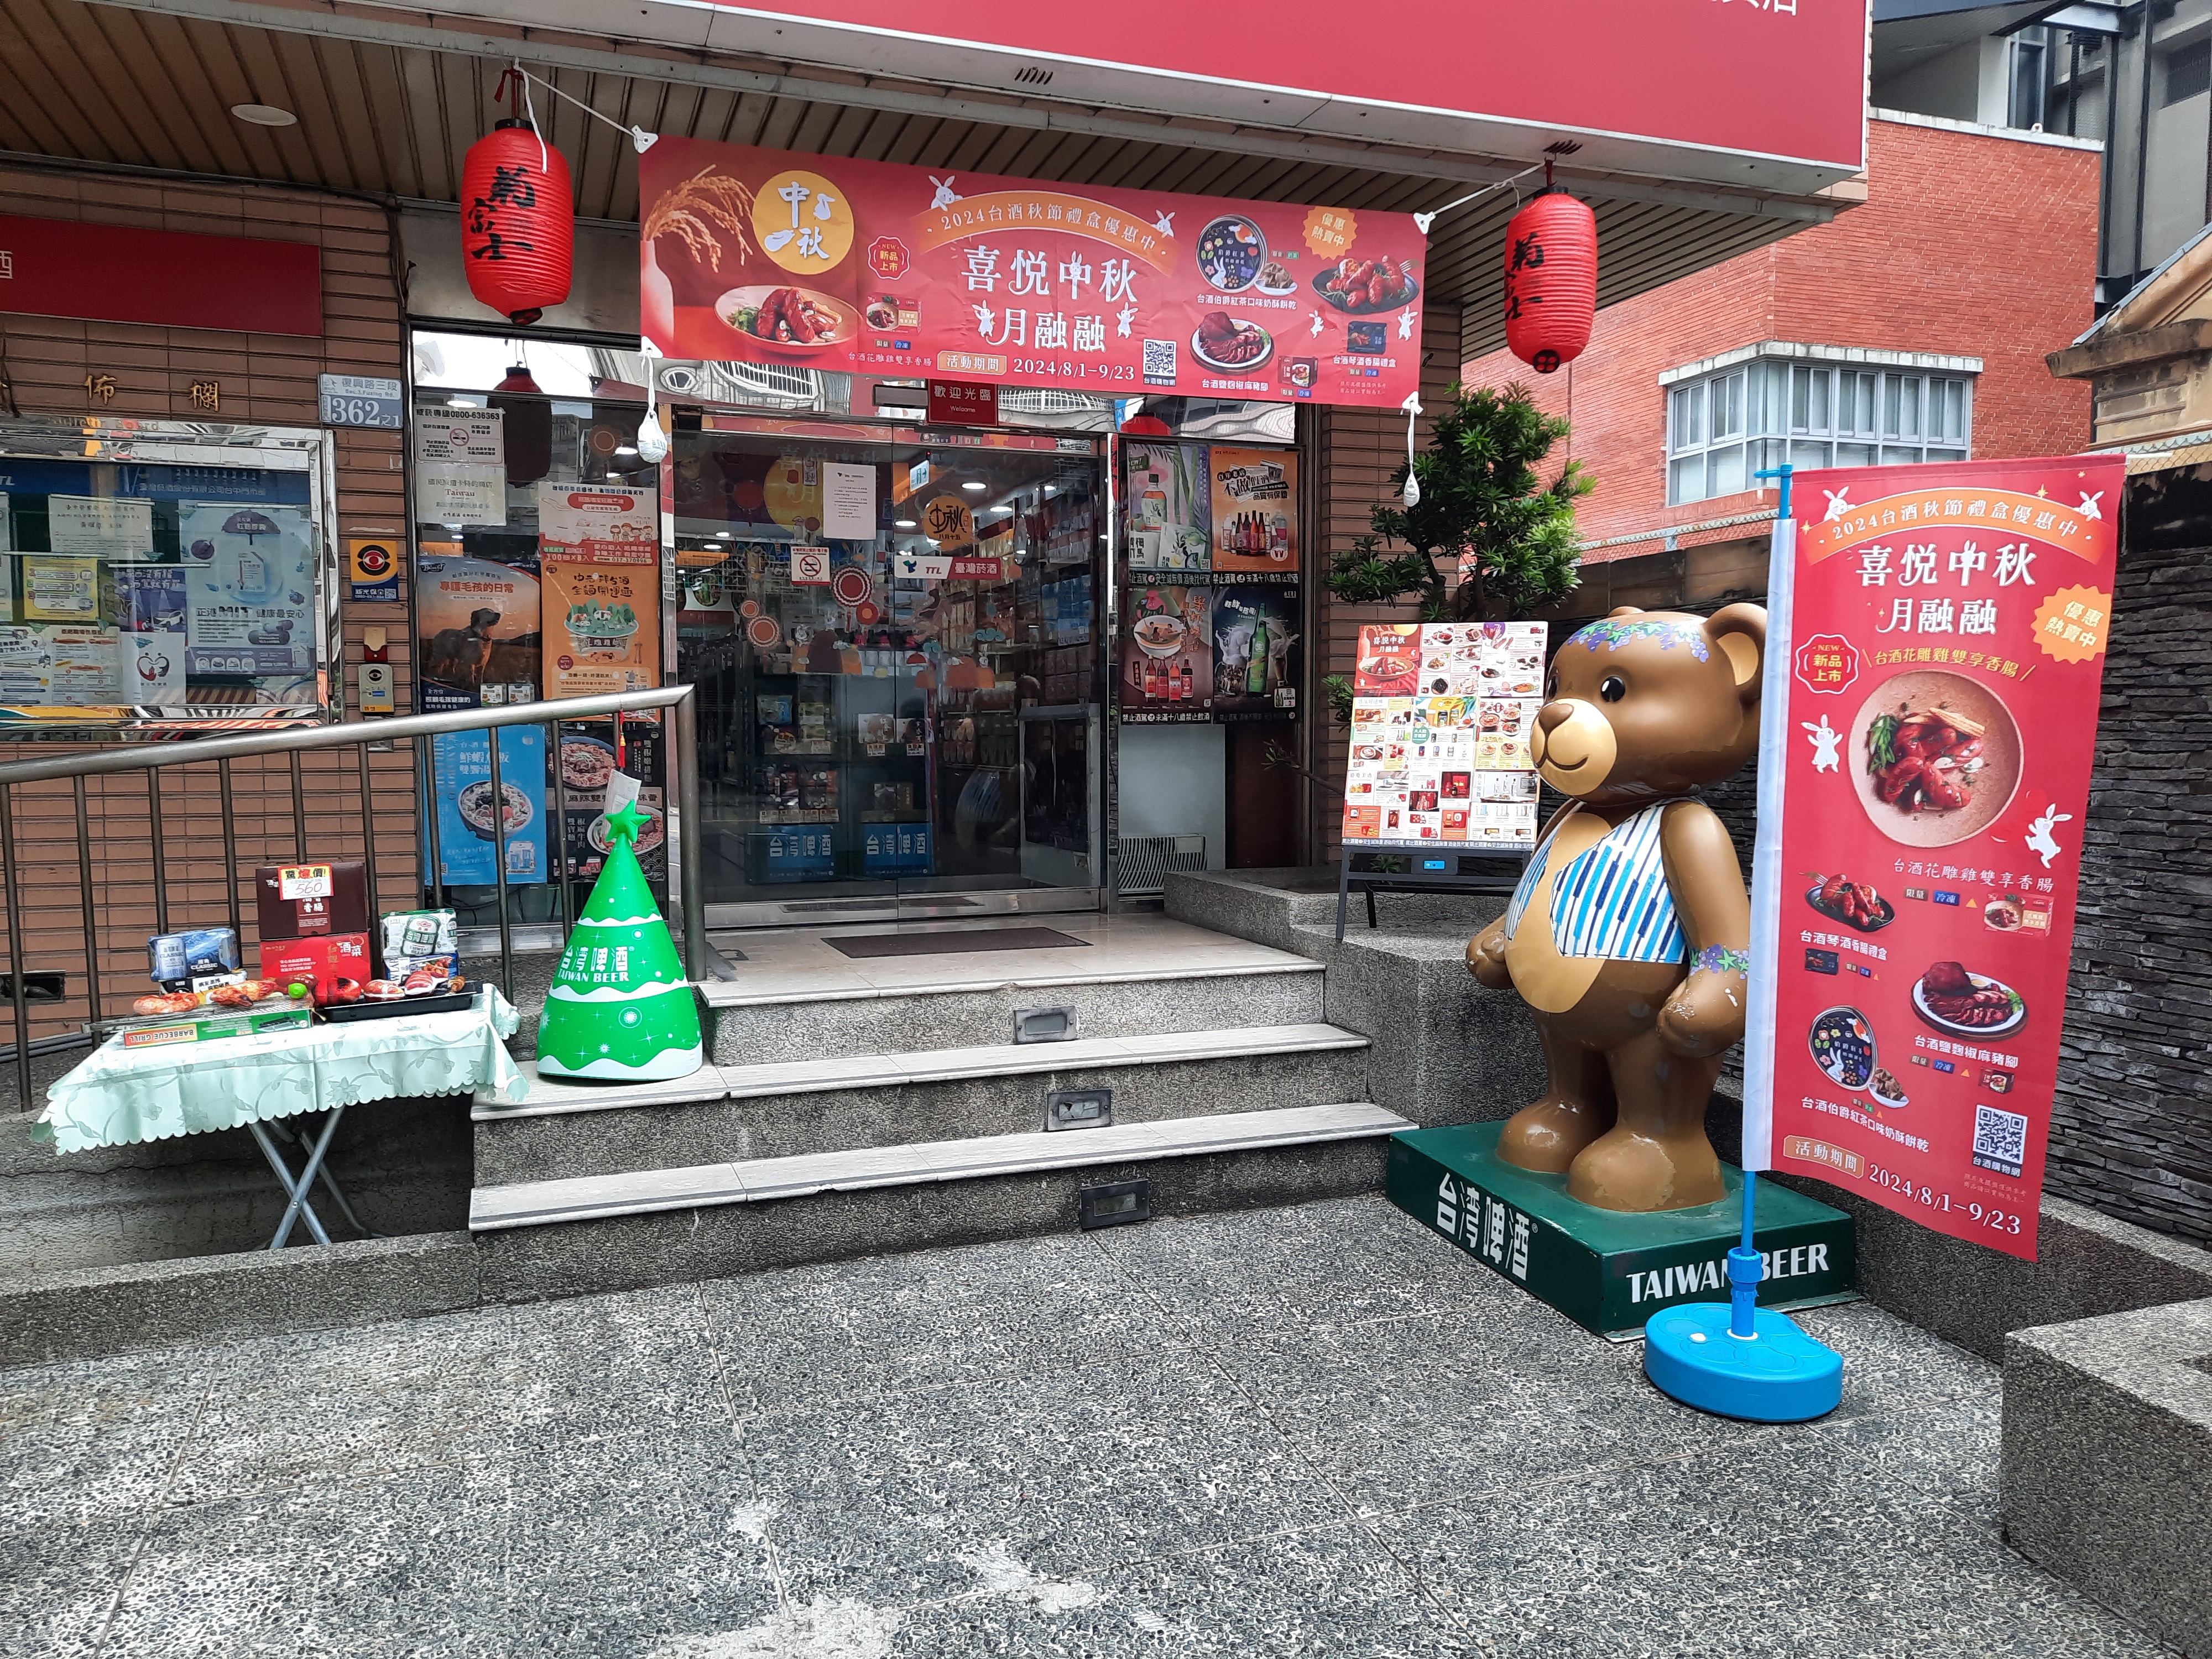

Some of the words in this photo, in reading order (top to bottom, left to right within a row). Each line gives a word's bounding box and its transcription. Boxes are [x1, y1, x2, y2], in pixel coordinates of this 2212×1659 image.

[941, 202, 1156, 251] 2024台酒秋節禮盒優惠中
[879, 250, 899, 261] 新品
[879, 262, 899, 273] 上市
[1197, 294, 1297, 310] 台酒伯爵紅茶口味奶酥餅乾
[985, 308, 1107, 353] 月融融
[947, 354, 999, 372] 活動期間
[934, 385, 992, 402] 歡迎光臨
[1832, 499, 2078, 539] 2024台酒秋節禮盒優惠中
[925, 566, 942, 575] TTL
[954, 562, 997, 575] 臺灣菸酒
[1876, 597, 1997, 635] 月融融
[2063, 599, 2104, 628] 優惠
[2045, 617, 2098, 648] 熱賣中
[1813, 654, 1843, 667] 新品
[1873, 648, 2020, 677] 台酒花雕雞雙享香腸
[1812, 669, 1842, 683] 上市
[1894, 859, 2054, 892] 台酒花雕雞雙享香腸
[295, 879, 323, 895] 560
[1937, 892, 1957, 904] 冷凍
[1800, 930, 1887, 961] 台酒琴酒香腸禮盒
[558, 971, 589, 983] TAIWAN
[593, 971, 629, 983] BEER
[129, 1034, 152, 1043] GRILL
[154, 1029, 194, 1040] BARBECUE
[1914, 1035, 2019, 1068] 台酒鹽麴椒麻豬腳
[1801, 1097, 1930, 1154] 台酒伯爵紅茶口味奶酥餅乾
[1973, 1156, 2021, 1177] 台酒購物網
[1794, 1140, 1858, 1172] 活動期間
[1869, 1164, 2021, 1235] 2024/8/1-9/23
